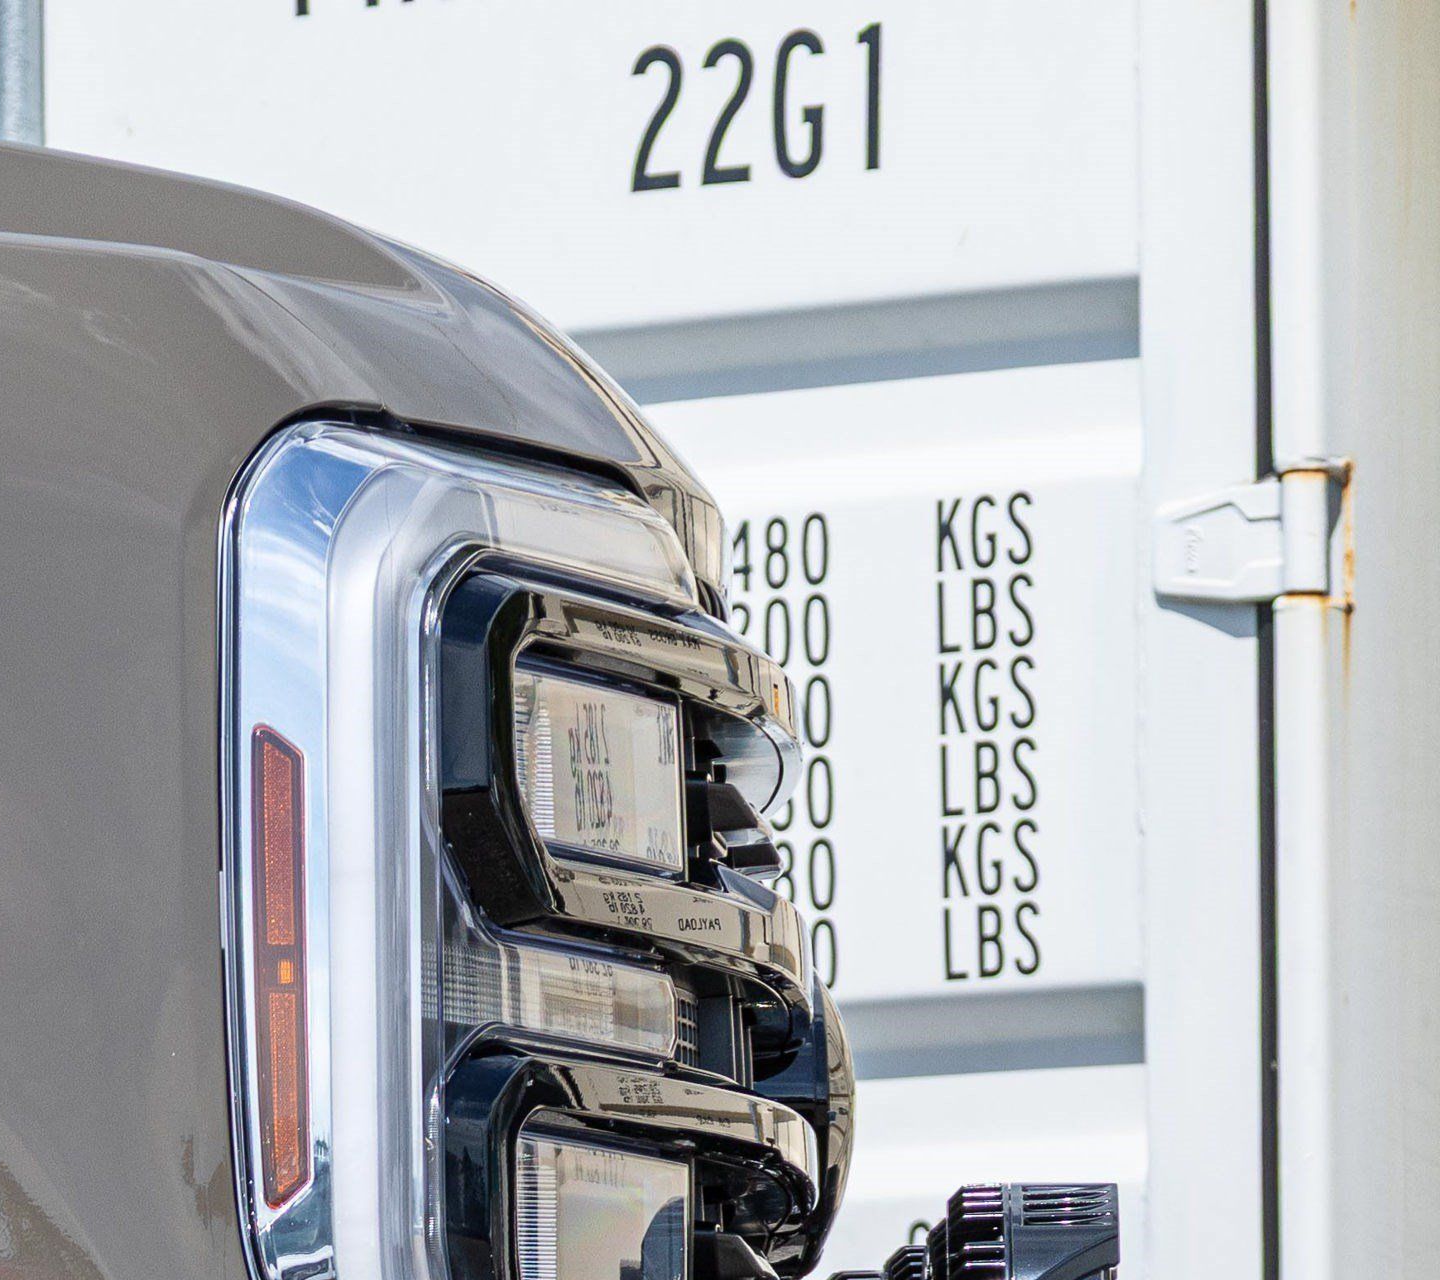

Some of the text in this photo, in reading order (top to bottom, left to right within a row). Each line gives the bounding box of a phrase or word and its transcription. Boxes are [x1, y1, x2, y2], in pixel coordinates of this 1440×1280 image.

[631, 22, 882, 193] 22G1
[937, 492, 1033, 573] KGS
[937, 573, 1034, 654] LBS
[939, 655, 1036, 736] KGS
[940, 737, 1037, 817] LBS
[942, 819, 1039, 899] KGS
[943, 901, 1040, 981] LBS
